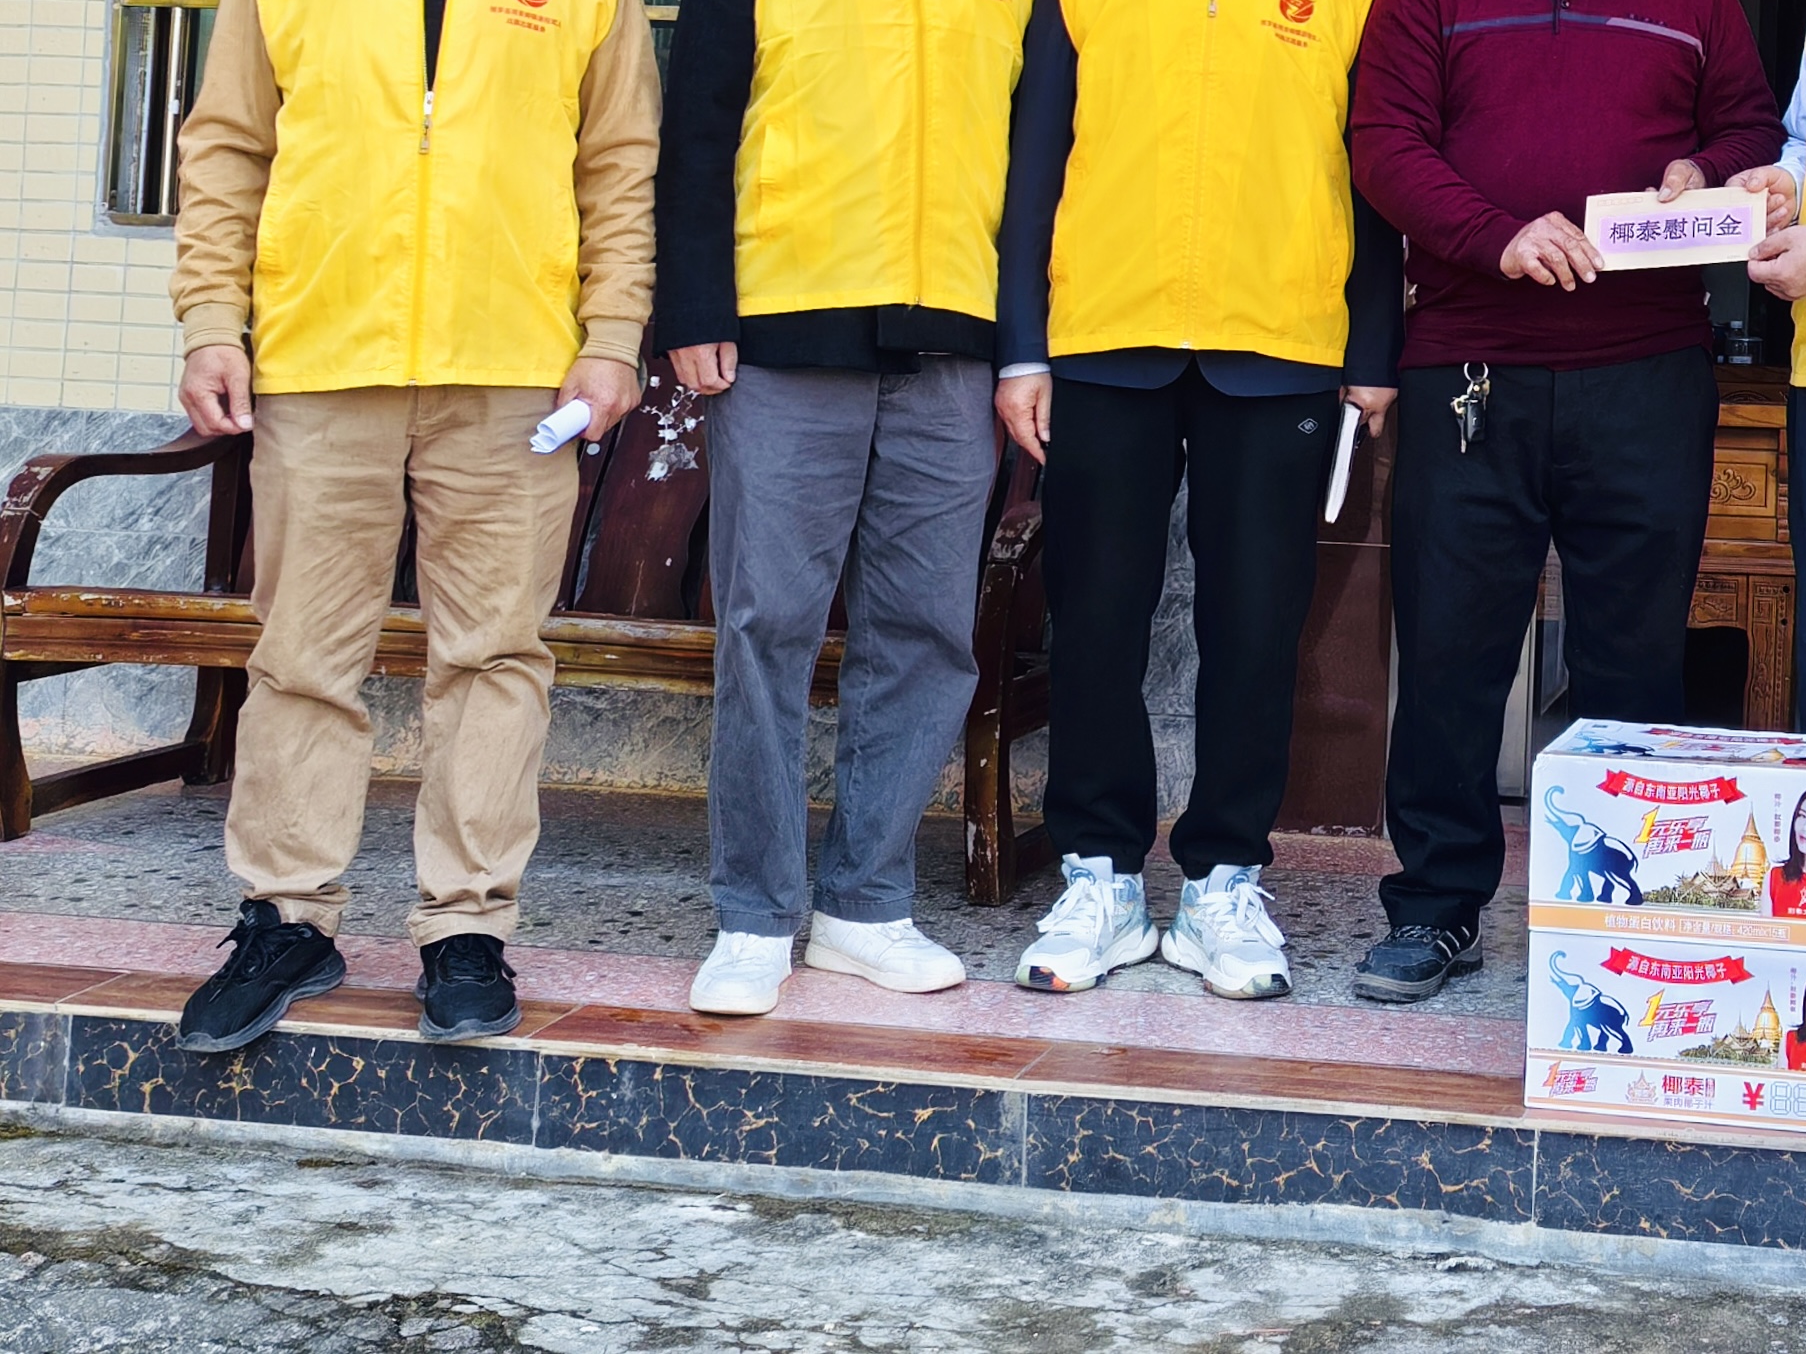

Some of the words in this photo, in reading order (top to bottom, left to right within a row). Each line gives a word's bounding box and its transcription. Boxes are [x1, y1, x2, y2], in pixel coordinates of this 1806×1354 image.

[1609, 214, 1742, 244] 椰泰慰问金
[1623, 777, 1720, 800] 源自东南亚阳光椰子
[1604, 913, 1676, 933] 植物蛋白饮料
[1626, 955, 1727, 980] 源自东南亚阳光椰子
[1662, 1074, 1704, 1096] 椰泰
[1664, 1097, 1713, 1110] 果肉椰子汁
